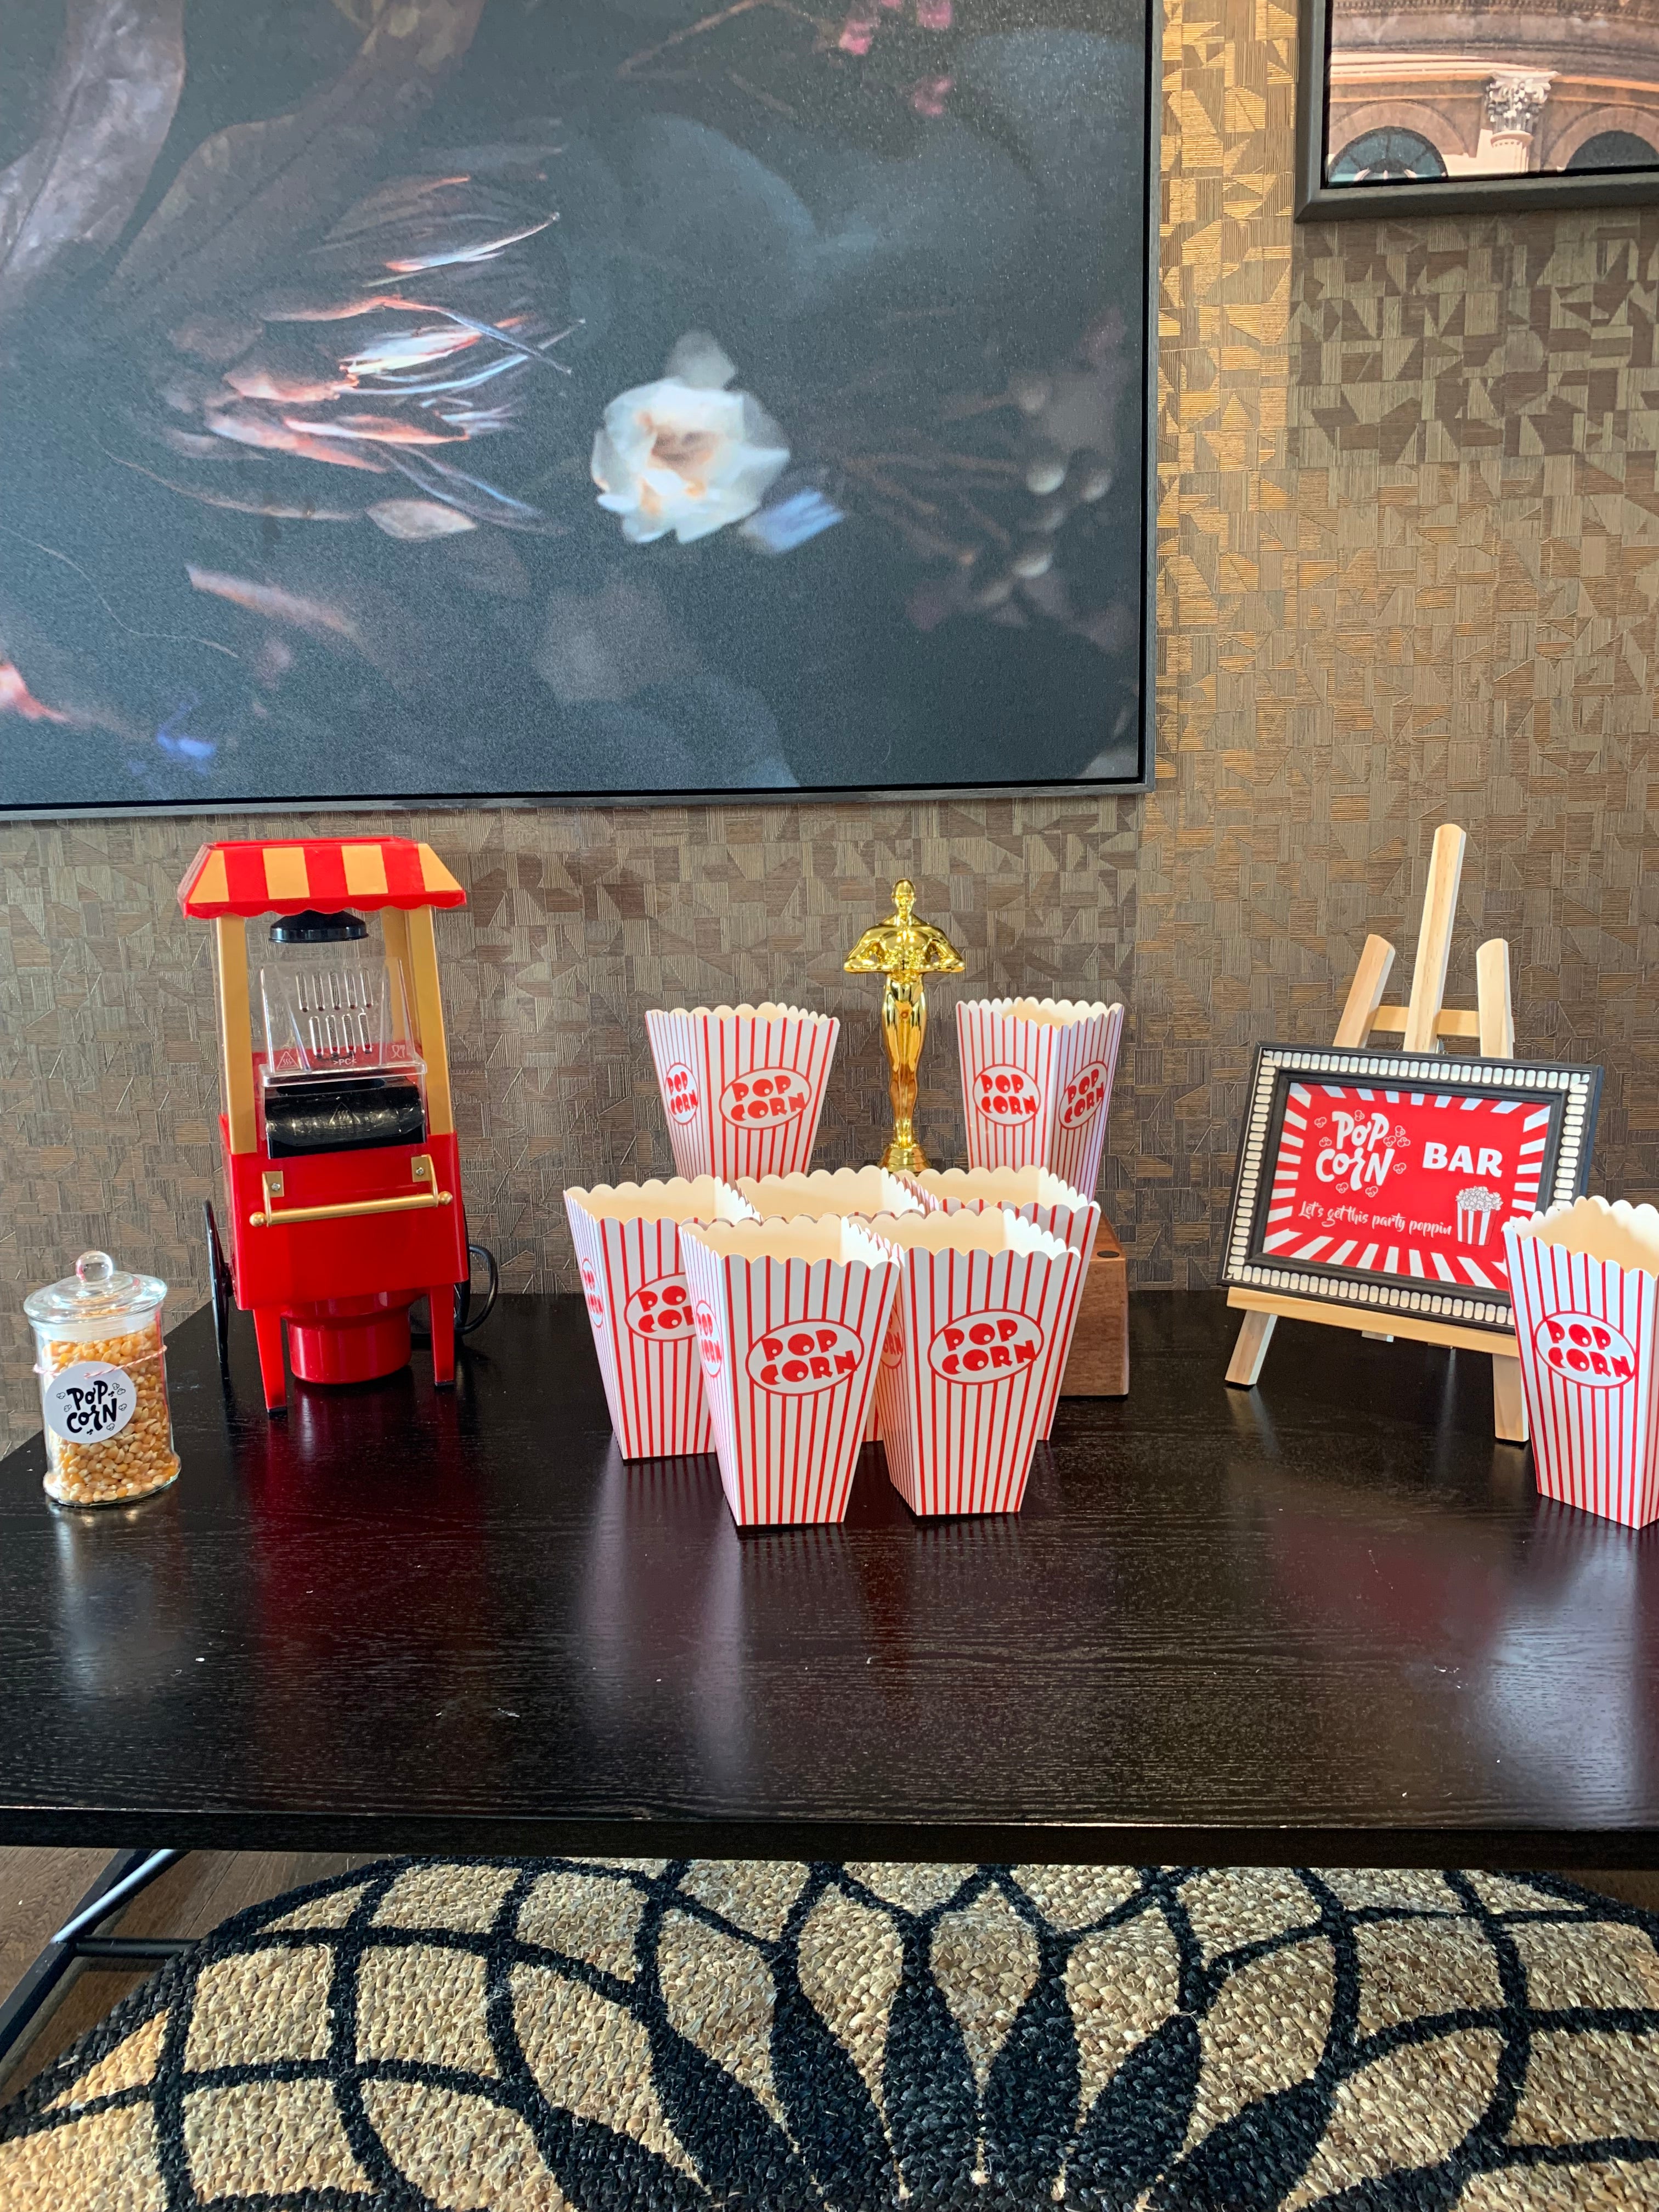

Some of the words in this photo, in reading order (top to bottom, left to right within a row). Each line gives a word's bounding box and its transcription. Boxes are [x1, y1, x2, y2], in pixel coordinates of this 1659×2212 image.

[666, 1071, 688, 1096] POP
[731, 1075, 791, 1102] POP
[980, 1074, 1024, 1094] POP
[1068, 1069, 1099, 1105] POP
[670, 1089, 698, 1115] CORN
[730, 1092, 806, 1121] CORN
[981, 1095, 1038, 1116] CORN
[1064, 1081, 1104, 1124] CORN
[1422, 1142, 1503, 1178] BAR
[1298, 1200, 1324, 1220] Let's
[1372, 1212, 1406, 1232] party
[1409, 1219, 1452, 1238] poppin
[761, 1329, 838, 1362] POP
[943, 1319, 1018, 1352] POP
[1546, 1320, 1611, 1350] POP
[760, 1350, 857, 1386] CORN
[941, 1340, 1037, 1375] CORN
[1548, 1347, 1633, 1380] CORN
